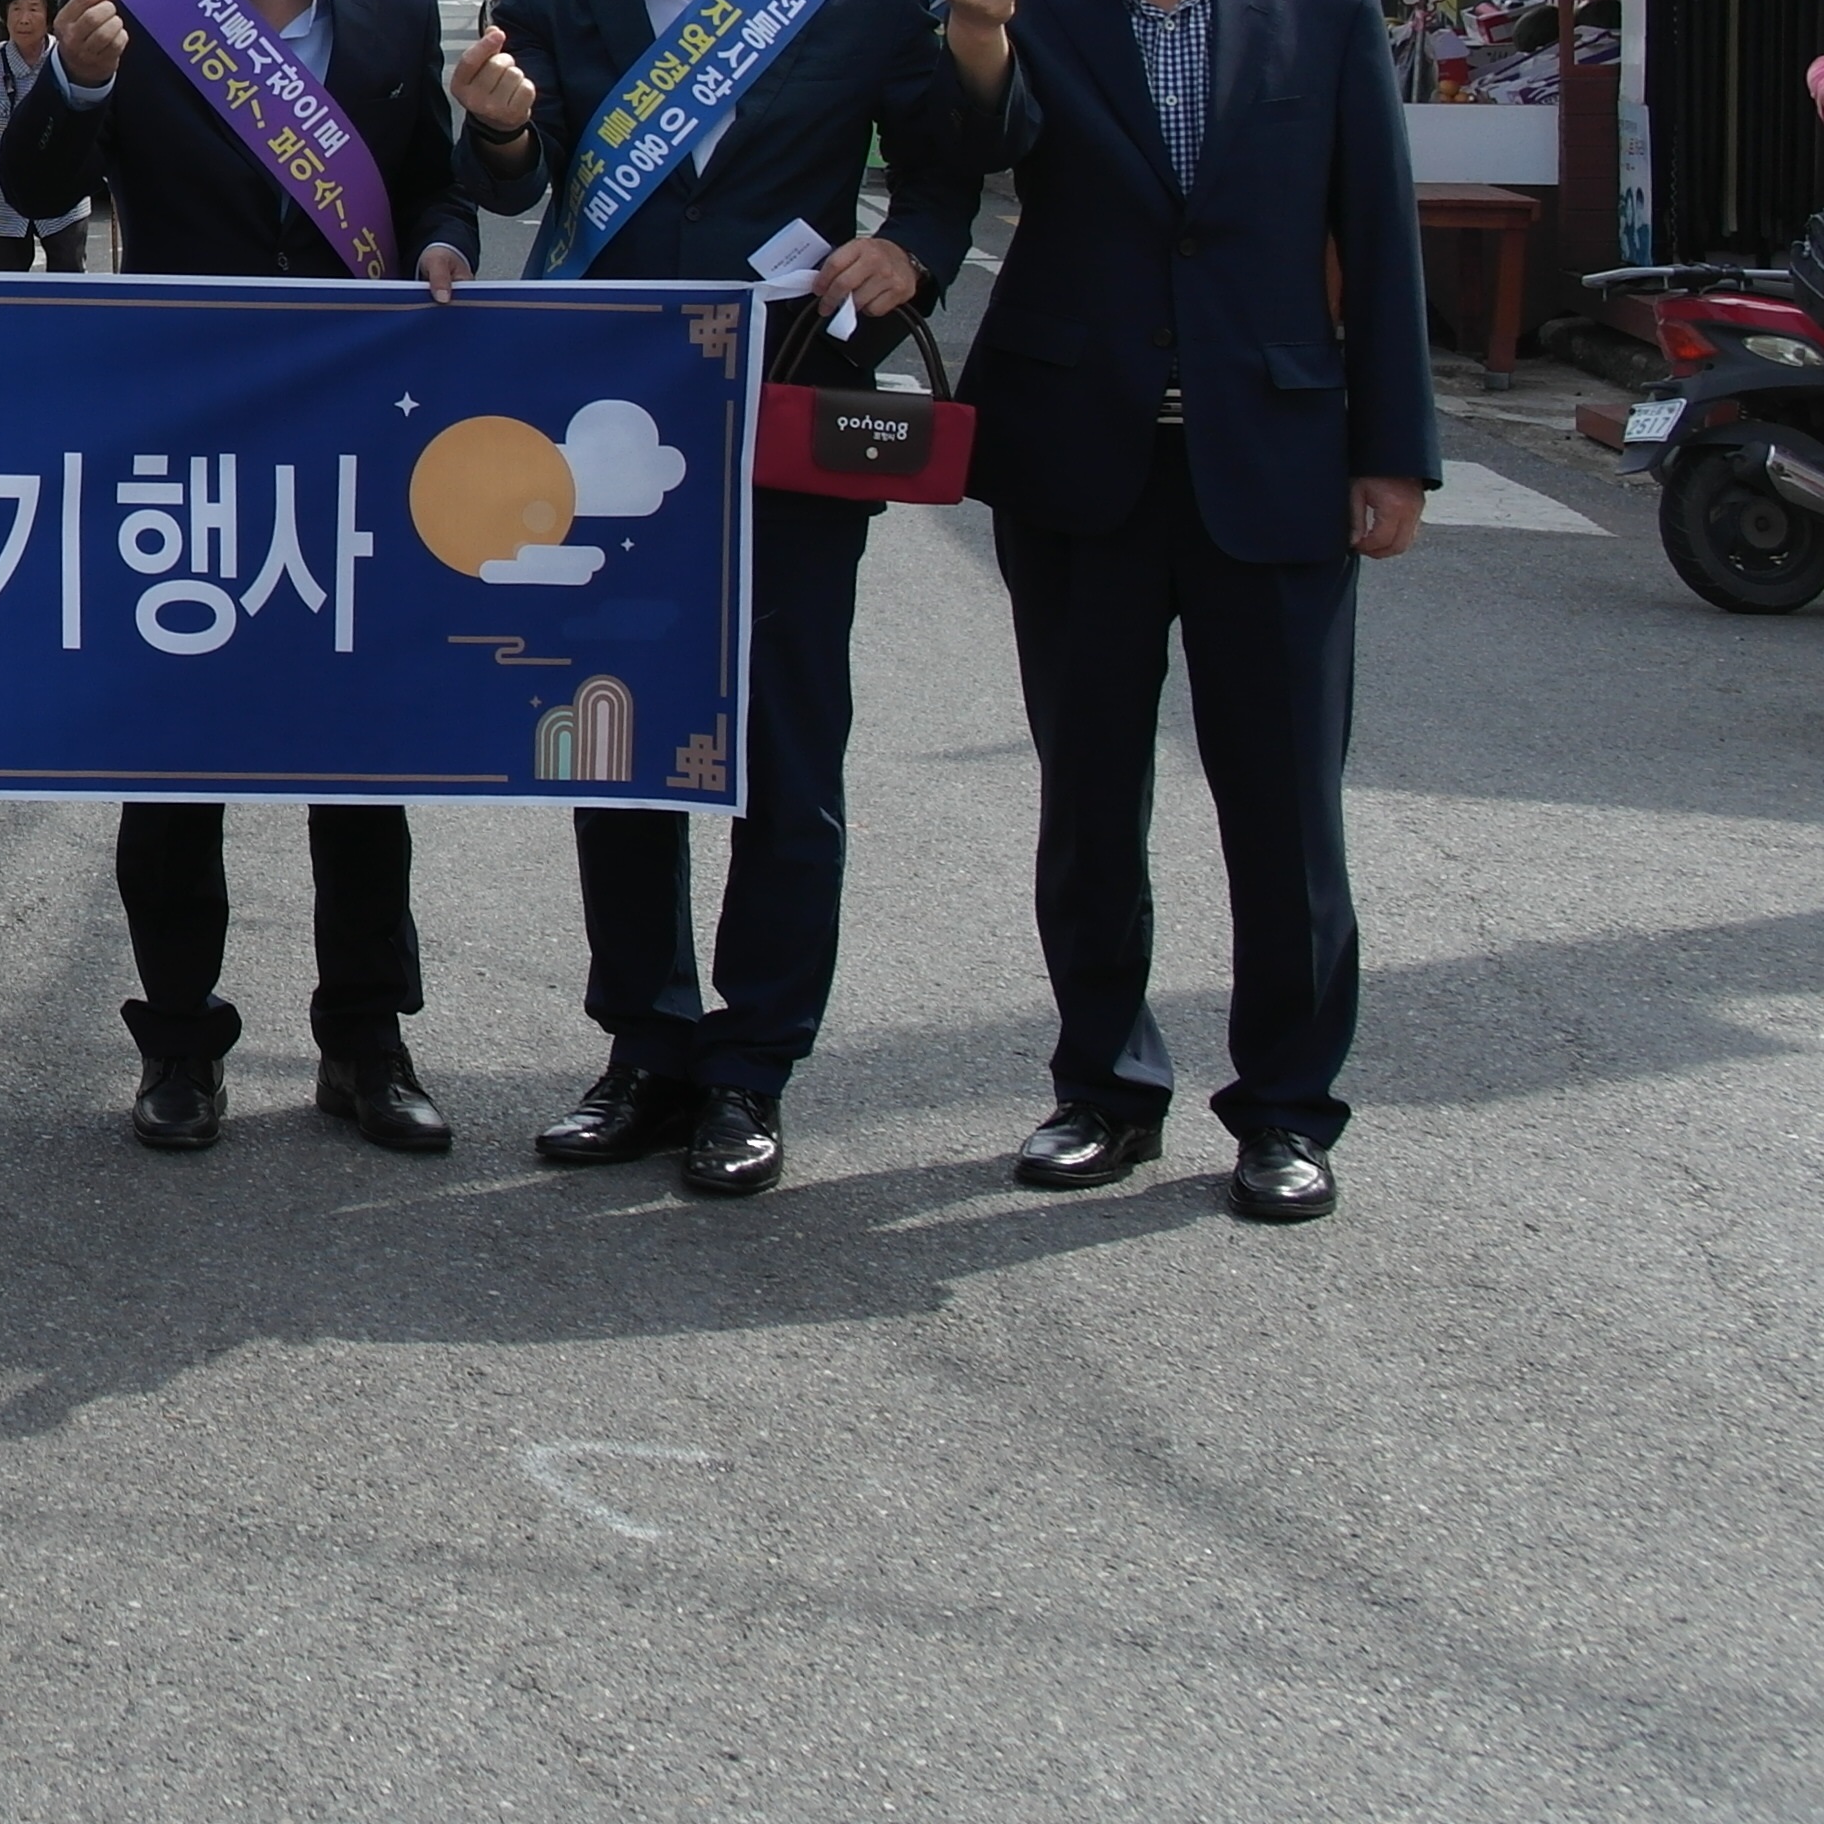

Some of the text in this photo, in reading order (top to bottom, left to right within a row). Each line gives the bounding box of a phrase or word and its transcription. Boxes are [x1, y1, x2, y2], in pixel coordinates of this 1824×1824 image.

[184, 33, 352, 236] 오이소! 보이소!
[116, 452, 374, 655] 행사
